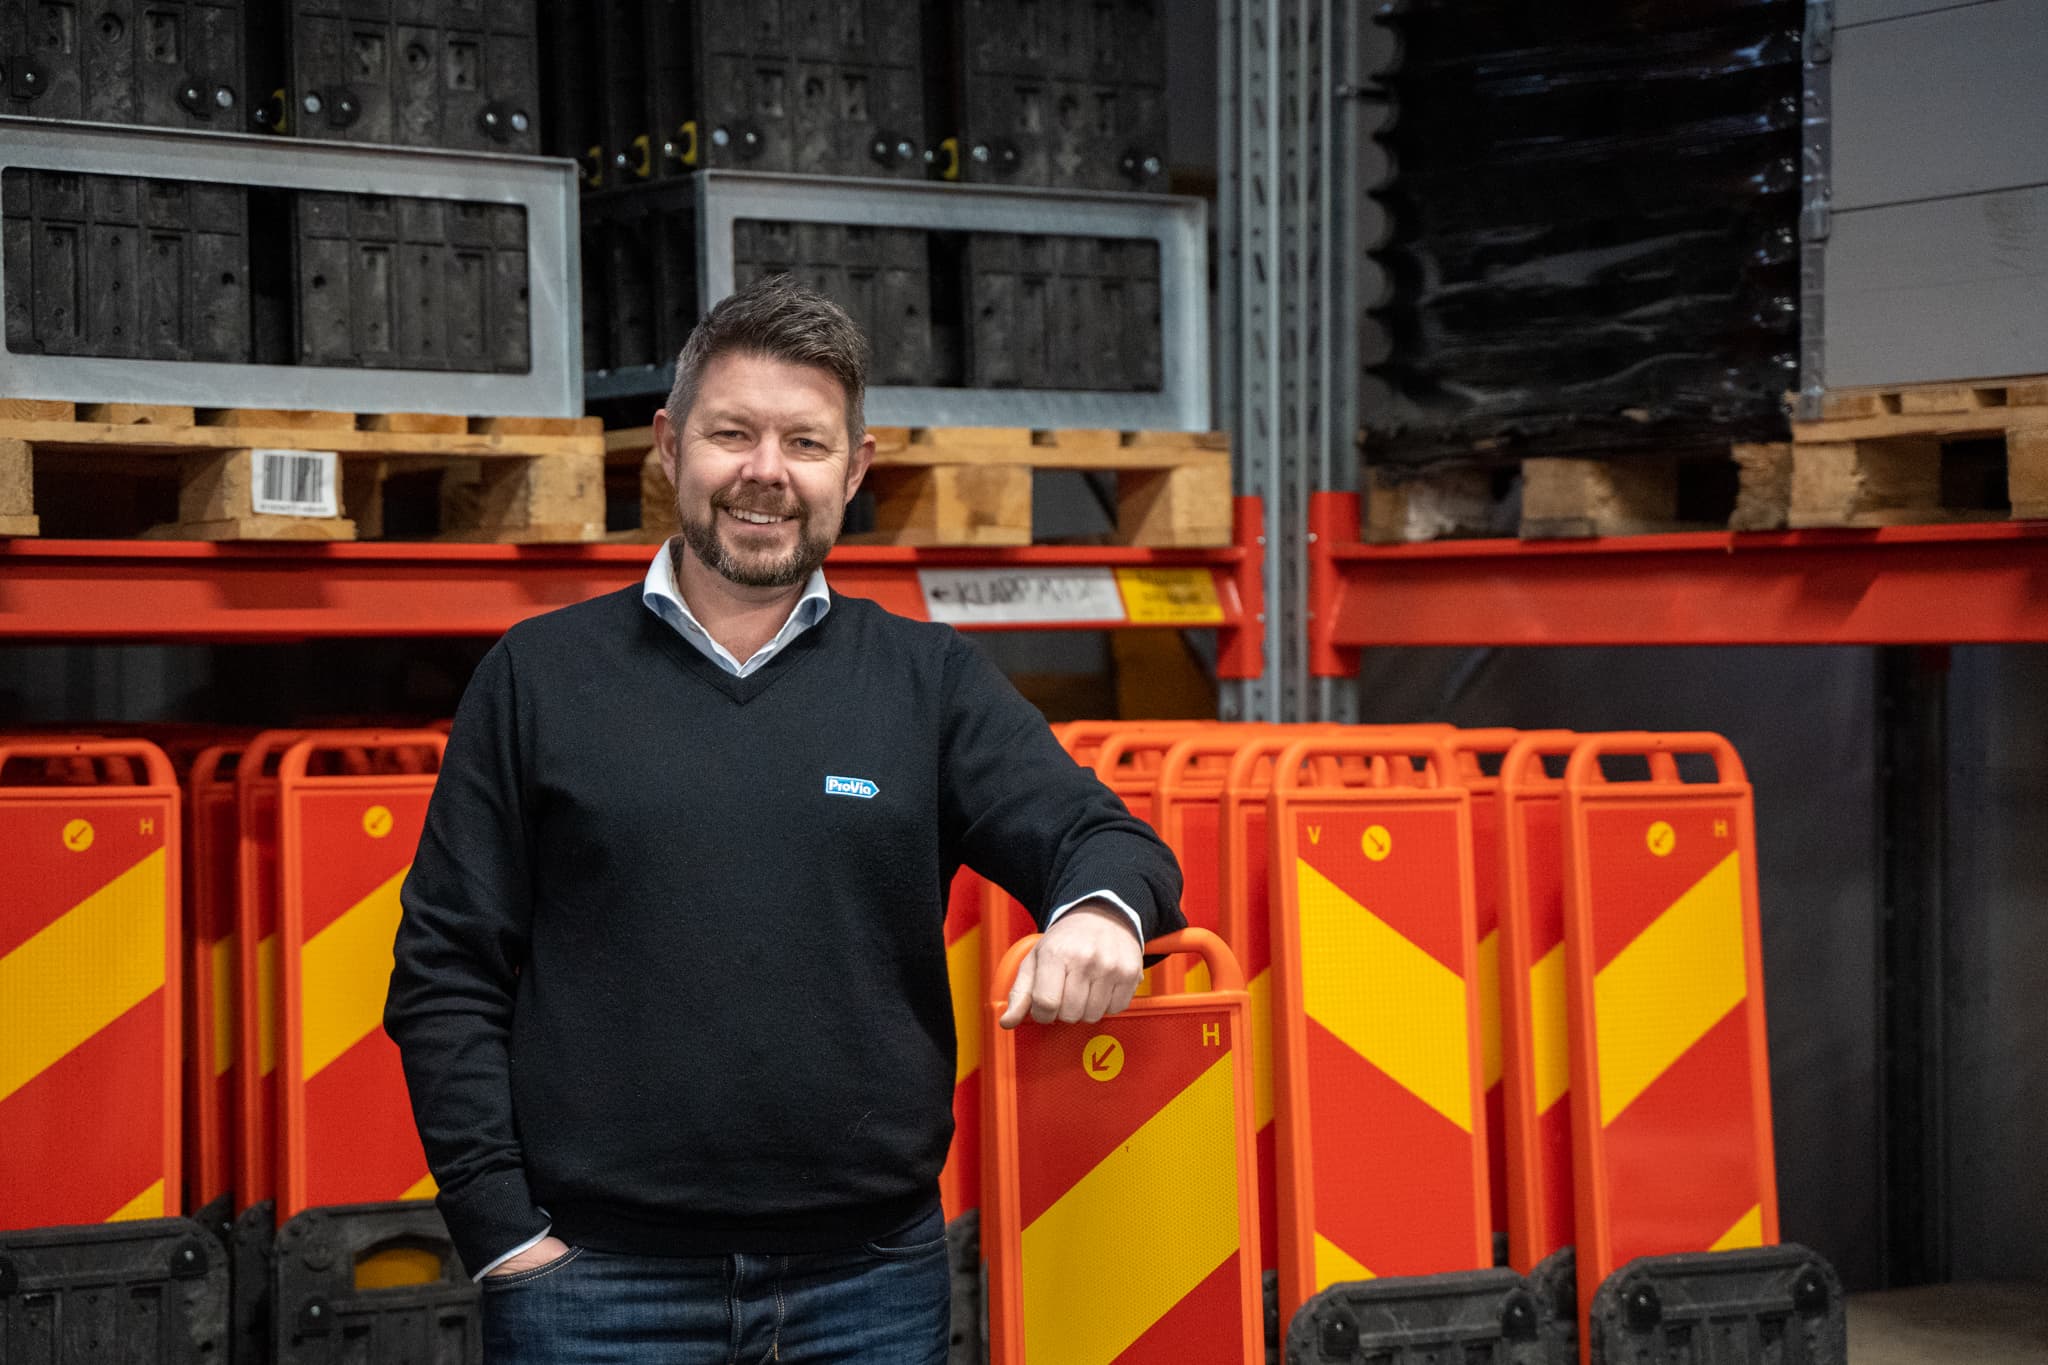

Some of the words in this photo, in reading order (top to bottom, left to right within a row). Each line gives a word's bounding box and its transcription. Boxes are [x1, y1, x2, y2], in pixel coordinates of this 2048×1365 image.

[828, 779, 872, 795] ProVia
[139, 818, 154, 836] H
[1307, 825, 1322, 844] V
[1713, 820, 1728, 838] H
[1202, 1023, 1220, 1047] H
